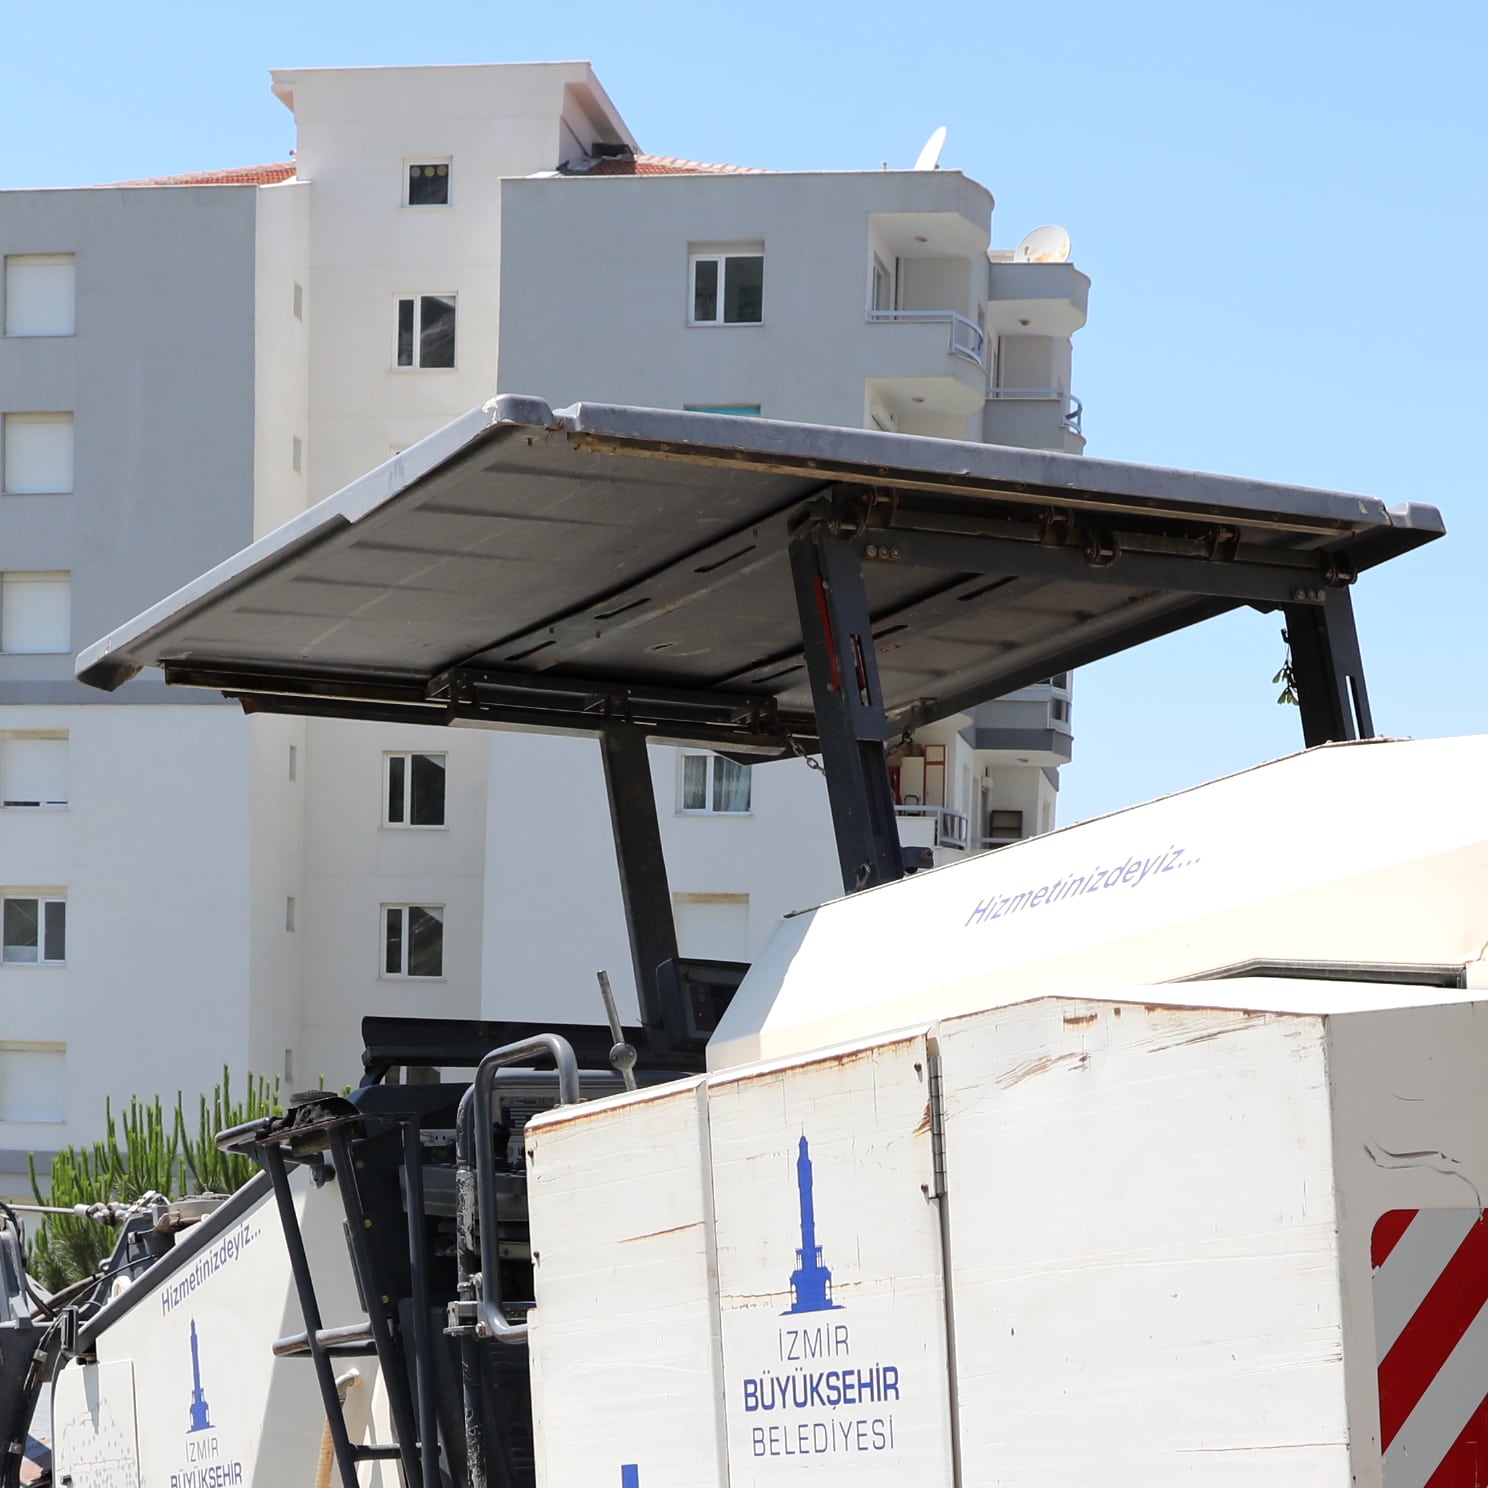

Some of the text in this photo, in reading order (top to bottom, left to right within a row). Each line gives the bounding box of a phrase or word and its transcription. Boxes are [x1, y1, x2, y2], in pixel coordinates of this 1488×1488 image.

[964, 845, 1200, 927] Hizmetinizdeyiz...
[162, 1223, 261, 1316] Hizmetinizdeyiz...
[778, 1323, 849, 1361] İZMİR
[744, 1363, 900, 1411] BÜYÜKŞEHİR
[186, 1437, 219, 1463] İZMİR
[753, 1415, 894, 1456] BELEDİYESİ
